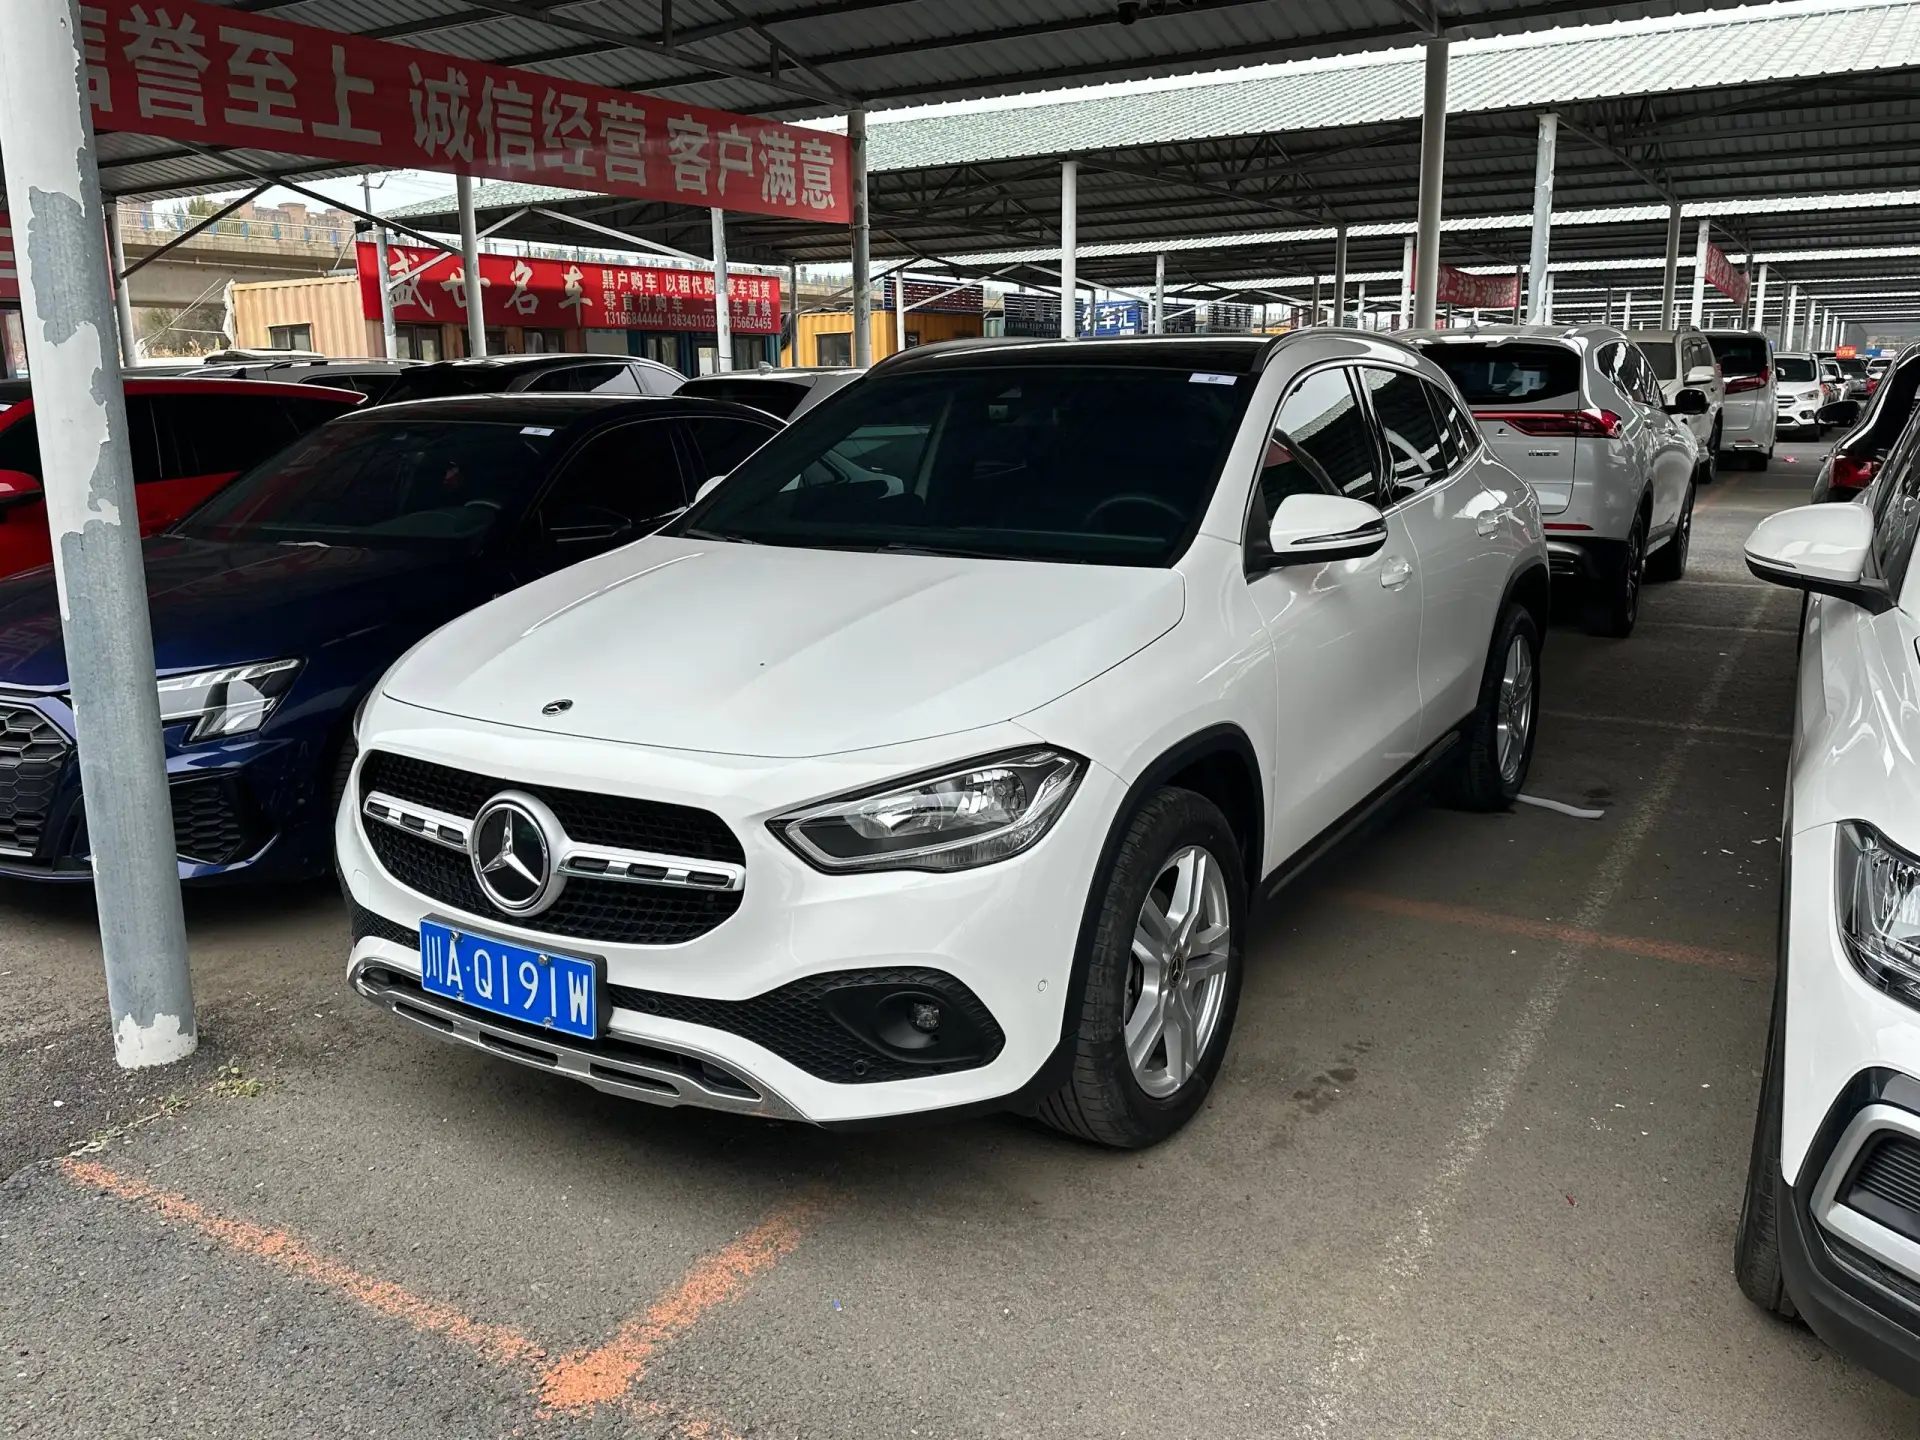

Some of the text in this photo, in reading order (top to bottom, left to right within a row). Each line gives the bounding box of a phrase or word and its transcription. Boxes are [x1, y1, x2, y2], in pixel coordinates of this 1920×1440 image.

[408, 61, 647, 187] 诚信经营
[667, 113, 836, 210] 客户满意
[389, 247, 593, 326] 盛世名车
[602, 269, 771, 299] 黑户购车 以租代购 豪车租赁
[603, 290, 772, 317] 零首付购车 二车置换
[604, 310, 772, 330] 13166844444 1363431123 756624455
